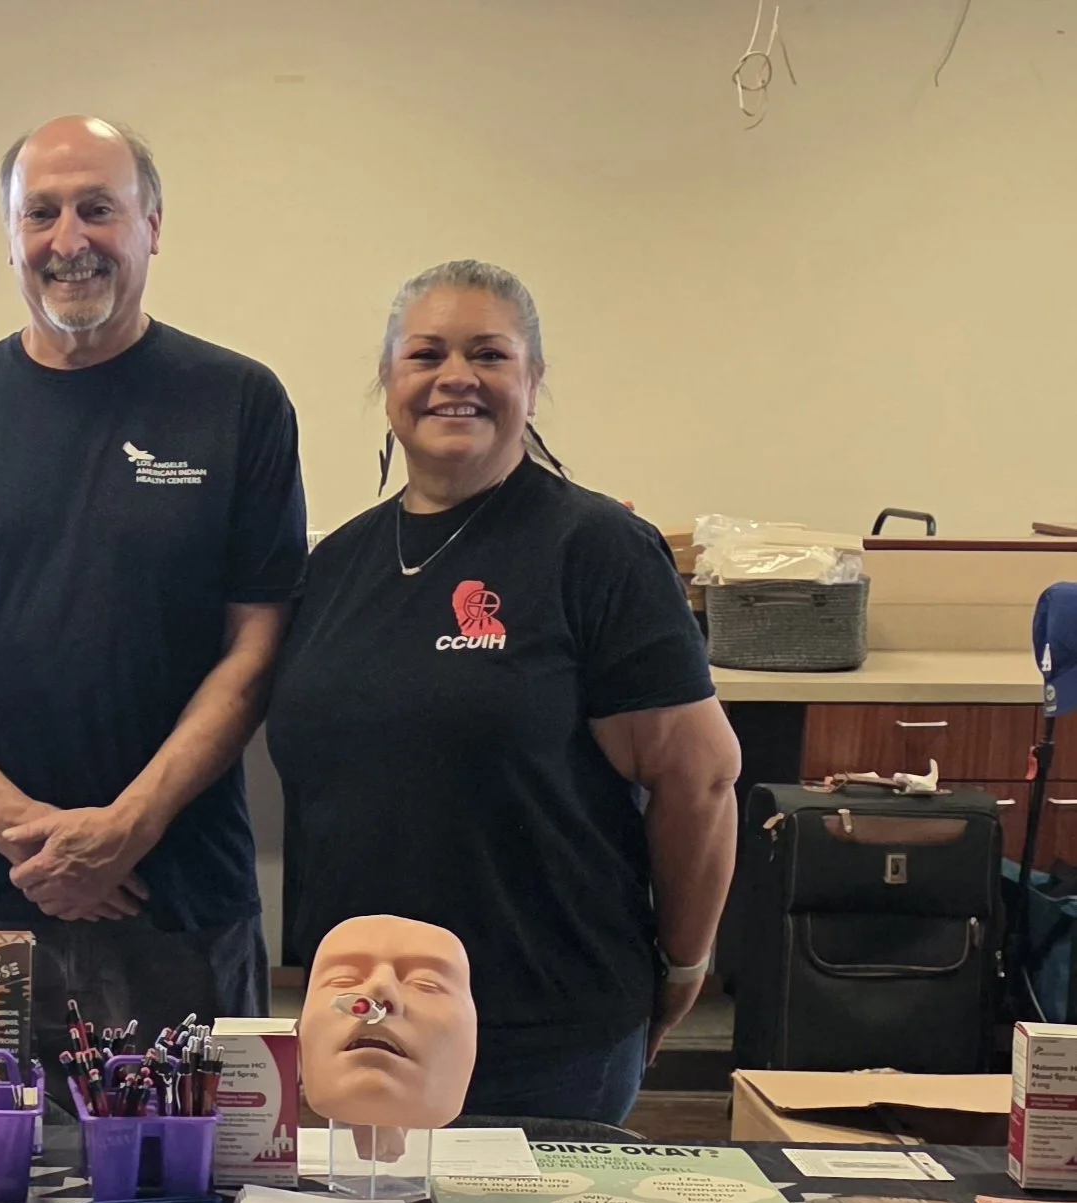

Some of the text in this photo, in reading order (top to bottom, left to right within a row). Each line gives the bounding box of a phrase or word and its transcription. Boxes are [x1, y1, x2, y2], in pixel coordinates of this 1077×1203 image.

[136, 459, 151, 467] LOS
[136, 468, 176, 476] AMERICAN
[136, 475, 165, 484] HEALTH
[436, 634, 506, 650] CCUIH
[620, 1146, 719, 1158] OKAY?
